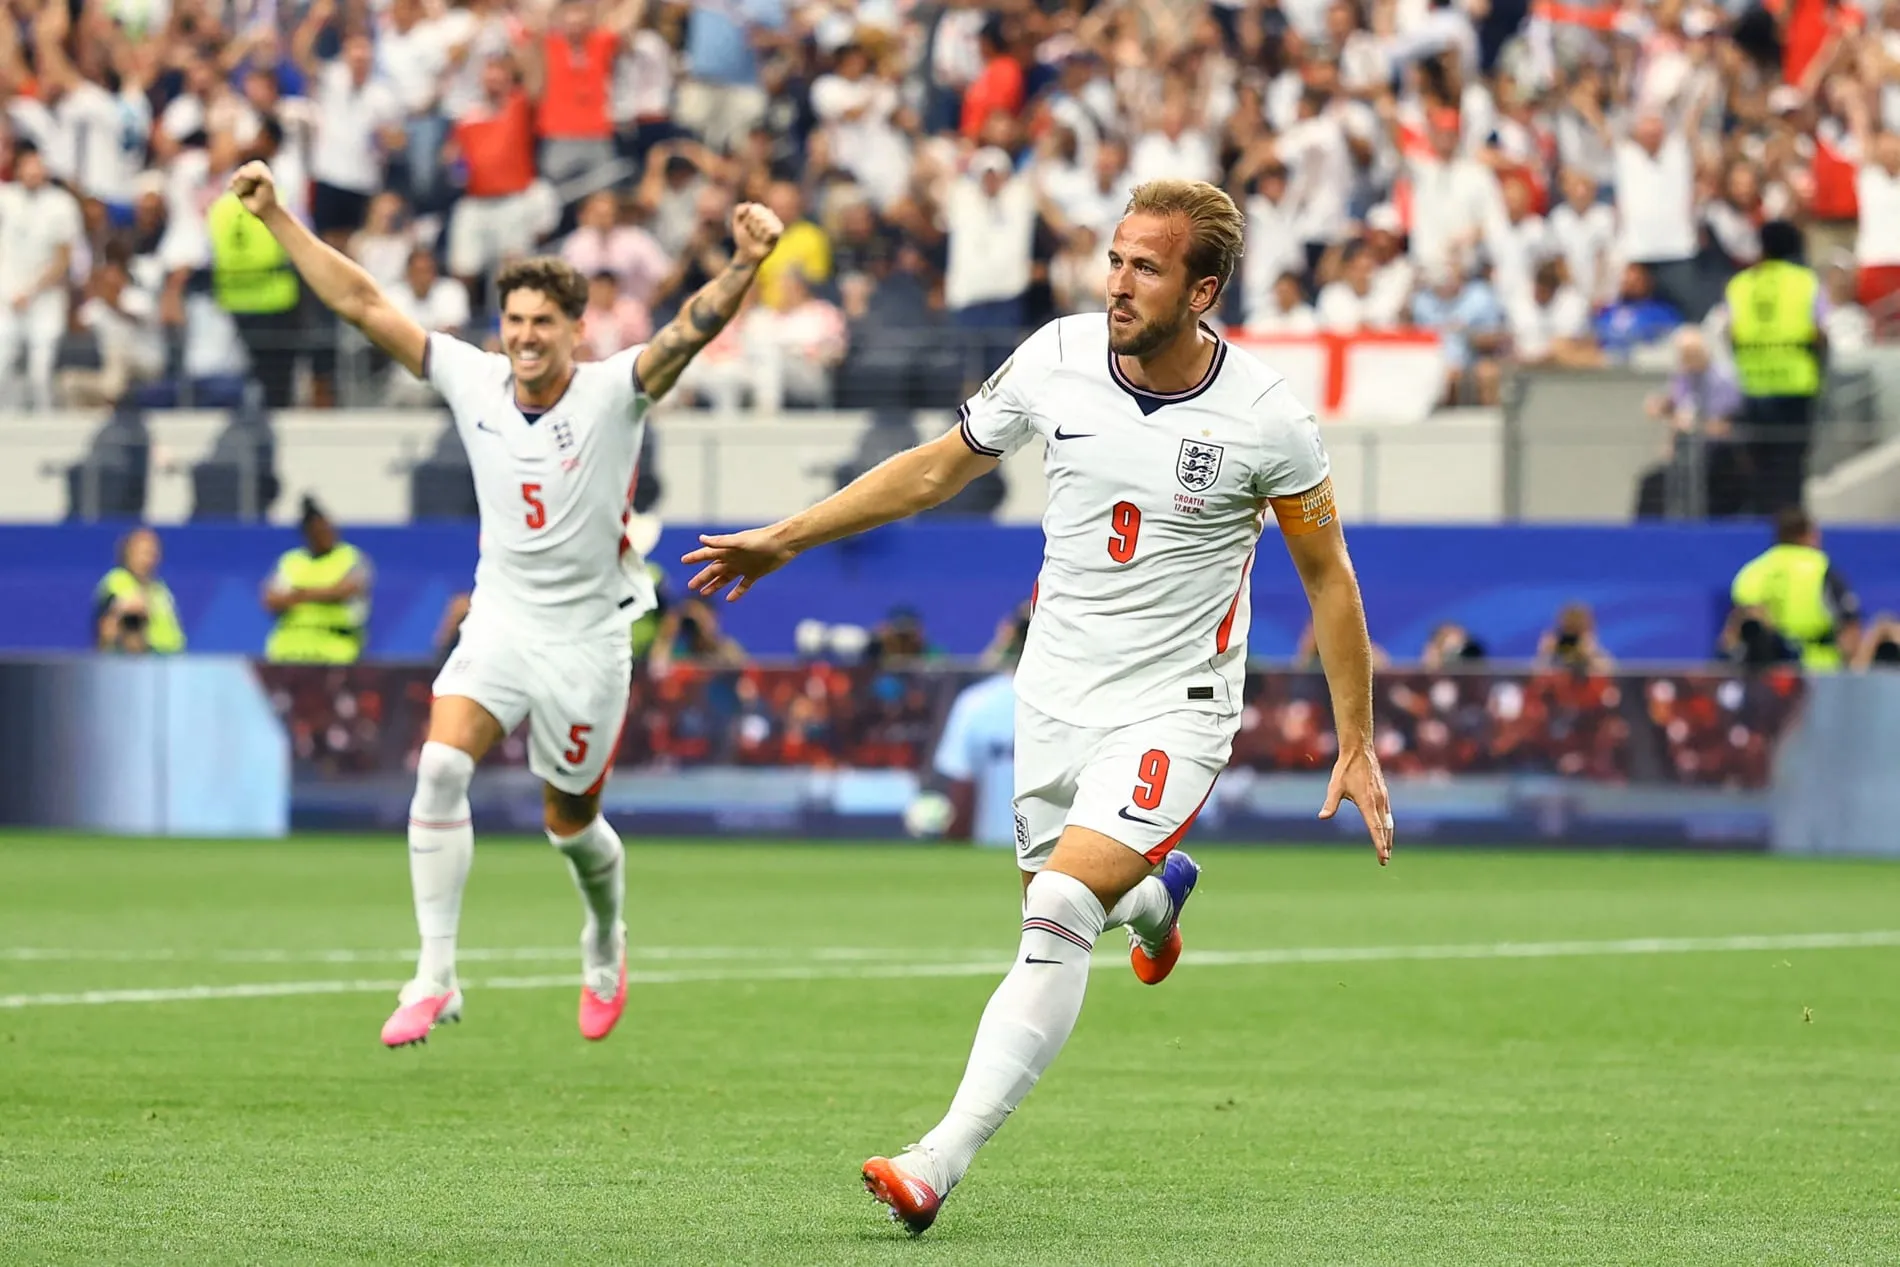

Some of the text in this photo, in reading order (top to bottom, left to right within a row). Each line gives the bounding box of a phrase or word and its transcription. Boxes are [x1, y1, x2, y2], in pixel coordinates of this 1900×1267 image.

[521, 483, 545, 529] 5
[1174, 493, 1205, 507] CROATIA
[1107, 500, 1141, 564] 9
[564, 723, 594, 765] 5
[1132, 748, 1170, 810] 9
